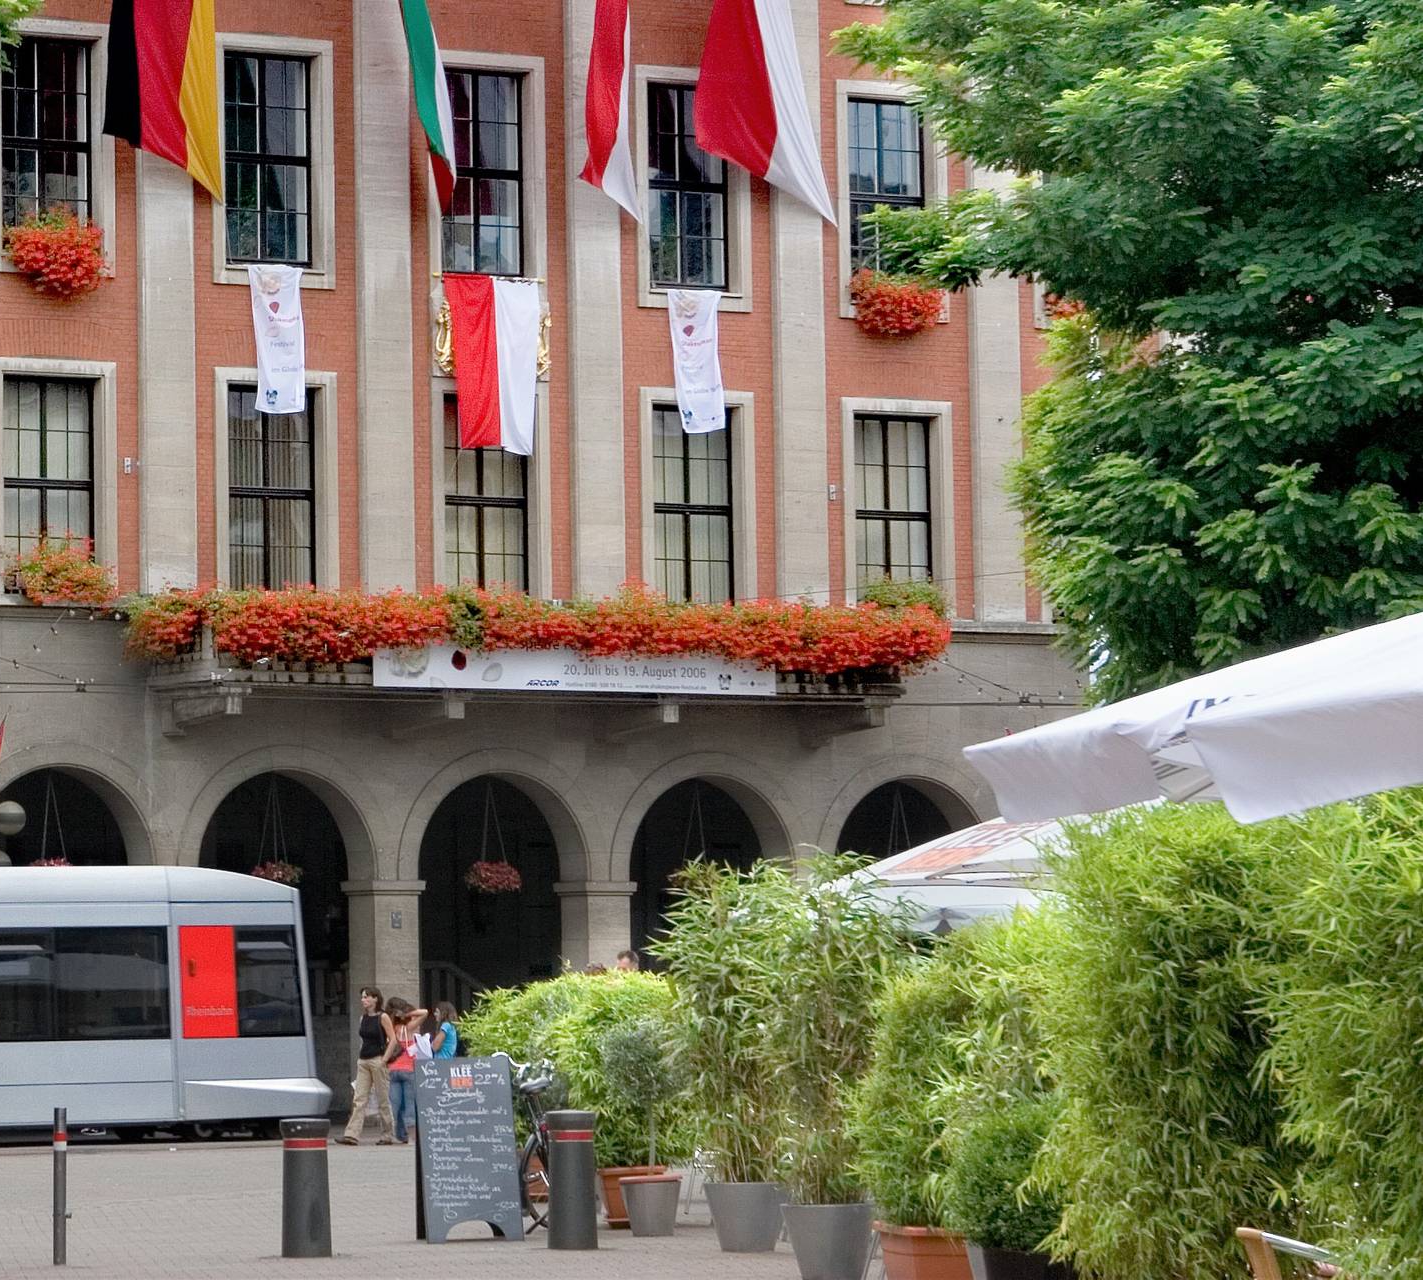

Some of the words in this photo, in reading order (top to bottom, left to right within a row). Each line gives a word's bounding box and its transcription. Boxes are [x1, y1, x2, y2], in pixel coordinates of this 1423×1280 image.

[563, 664, 581, 676] 20.
[583, 664, 601, 676] Juli
[605, 664, 619, 676] bis
[623, 665, 639, 677] 19.
[642, 666, 677, 680] August
[681, 667, 707, 679] 2006
[526, 679, 561, 687] ARCOR
[450, 1067, 472, 1078] KLEE
